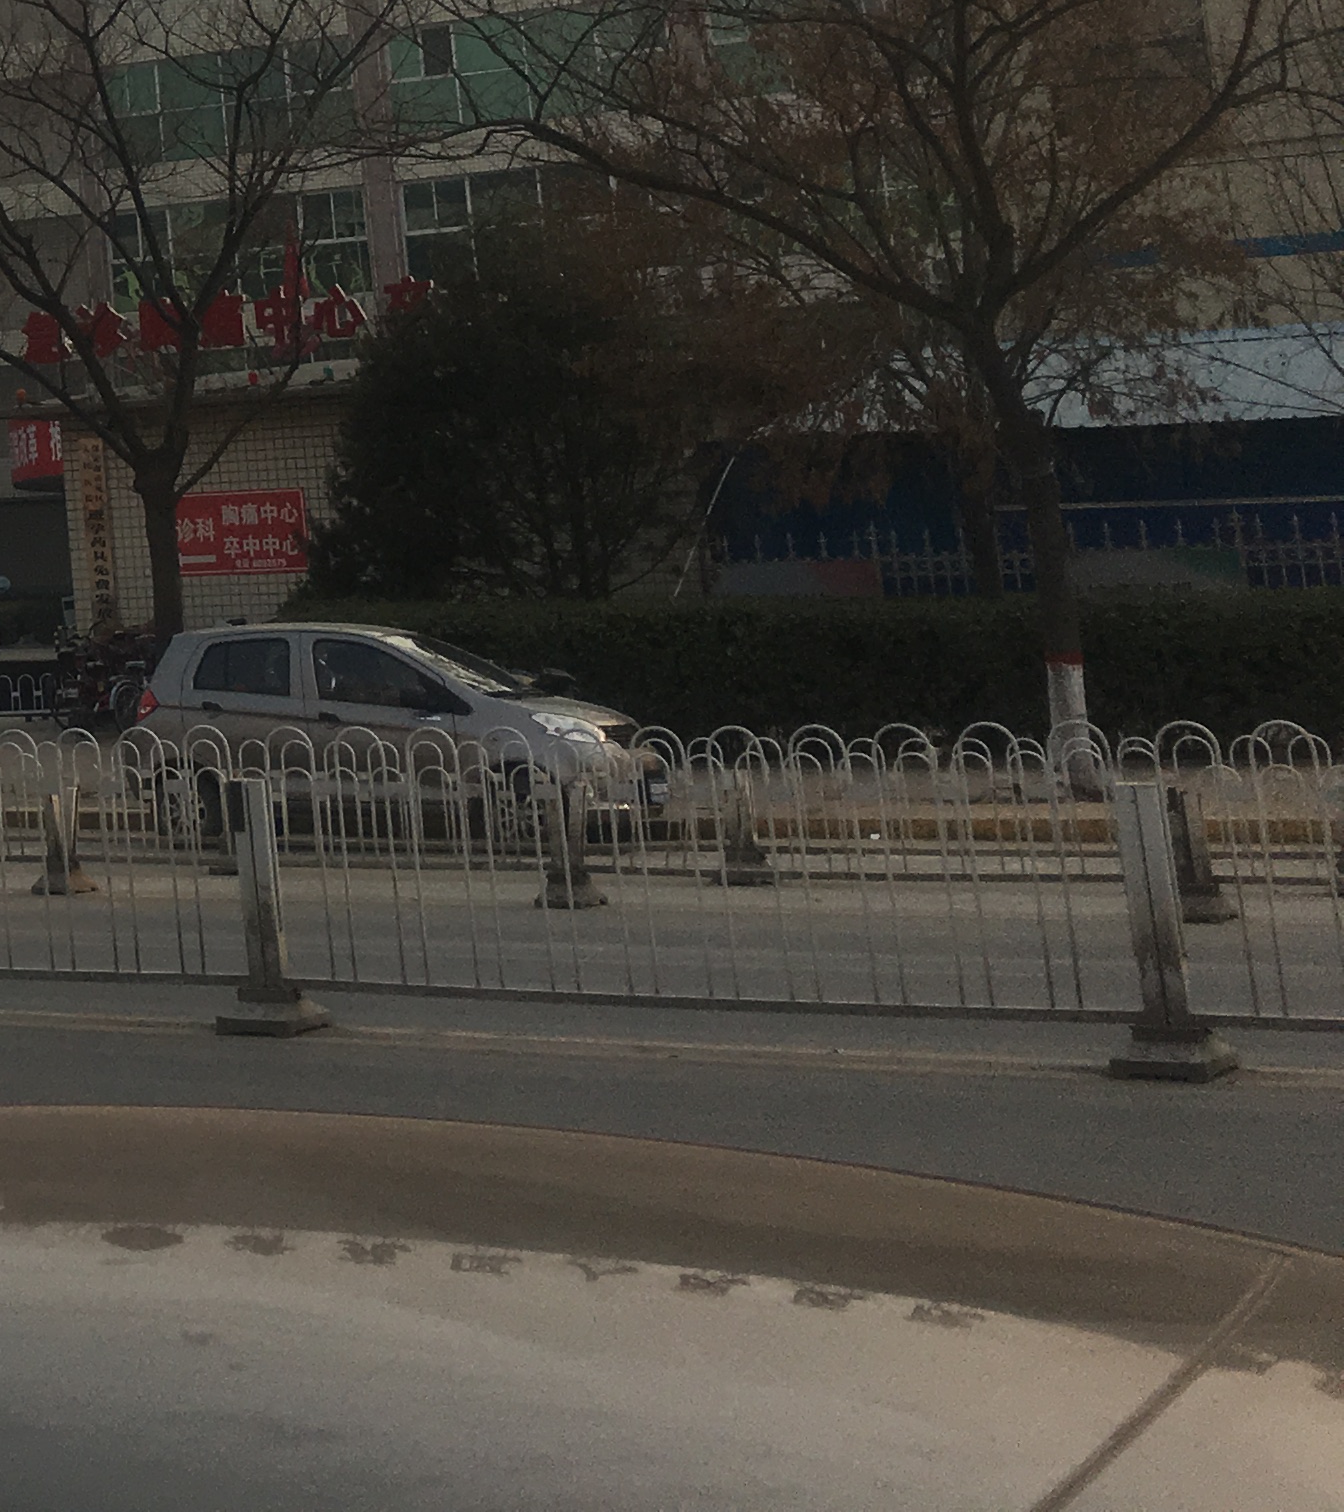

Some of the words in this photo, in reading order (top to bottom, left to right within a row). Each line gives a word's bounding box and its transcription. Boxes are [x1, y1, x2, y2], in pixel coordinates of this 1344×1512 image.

[221, 501, 299, 526] 胸痛中心
[223, 534, 299, 559] 卒中中心
